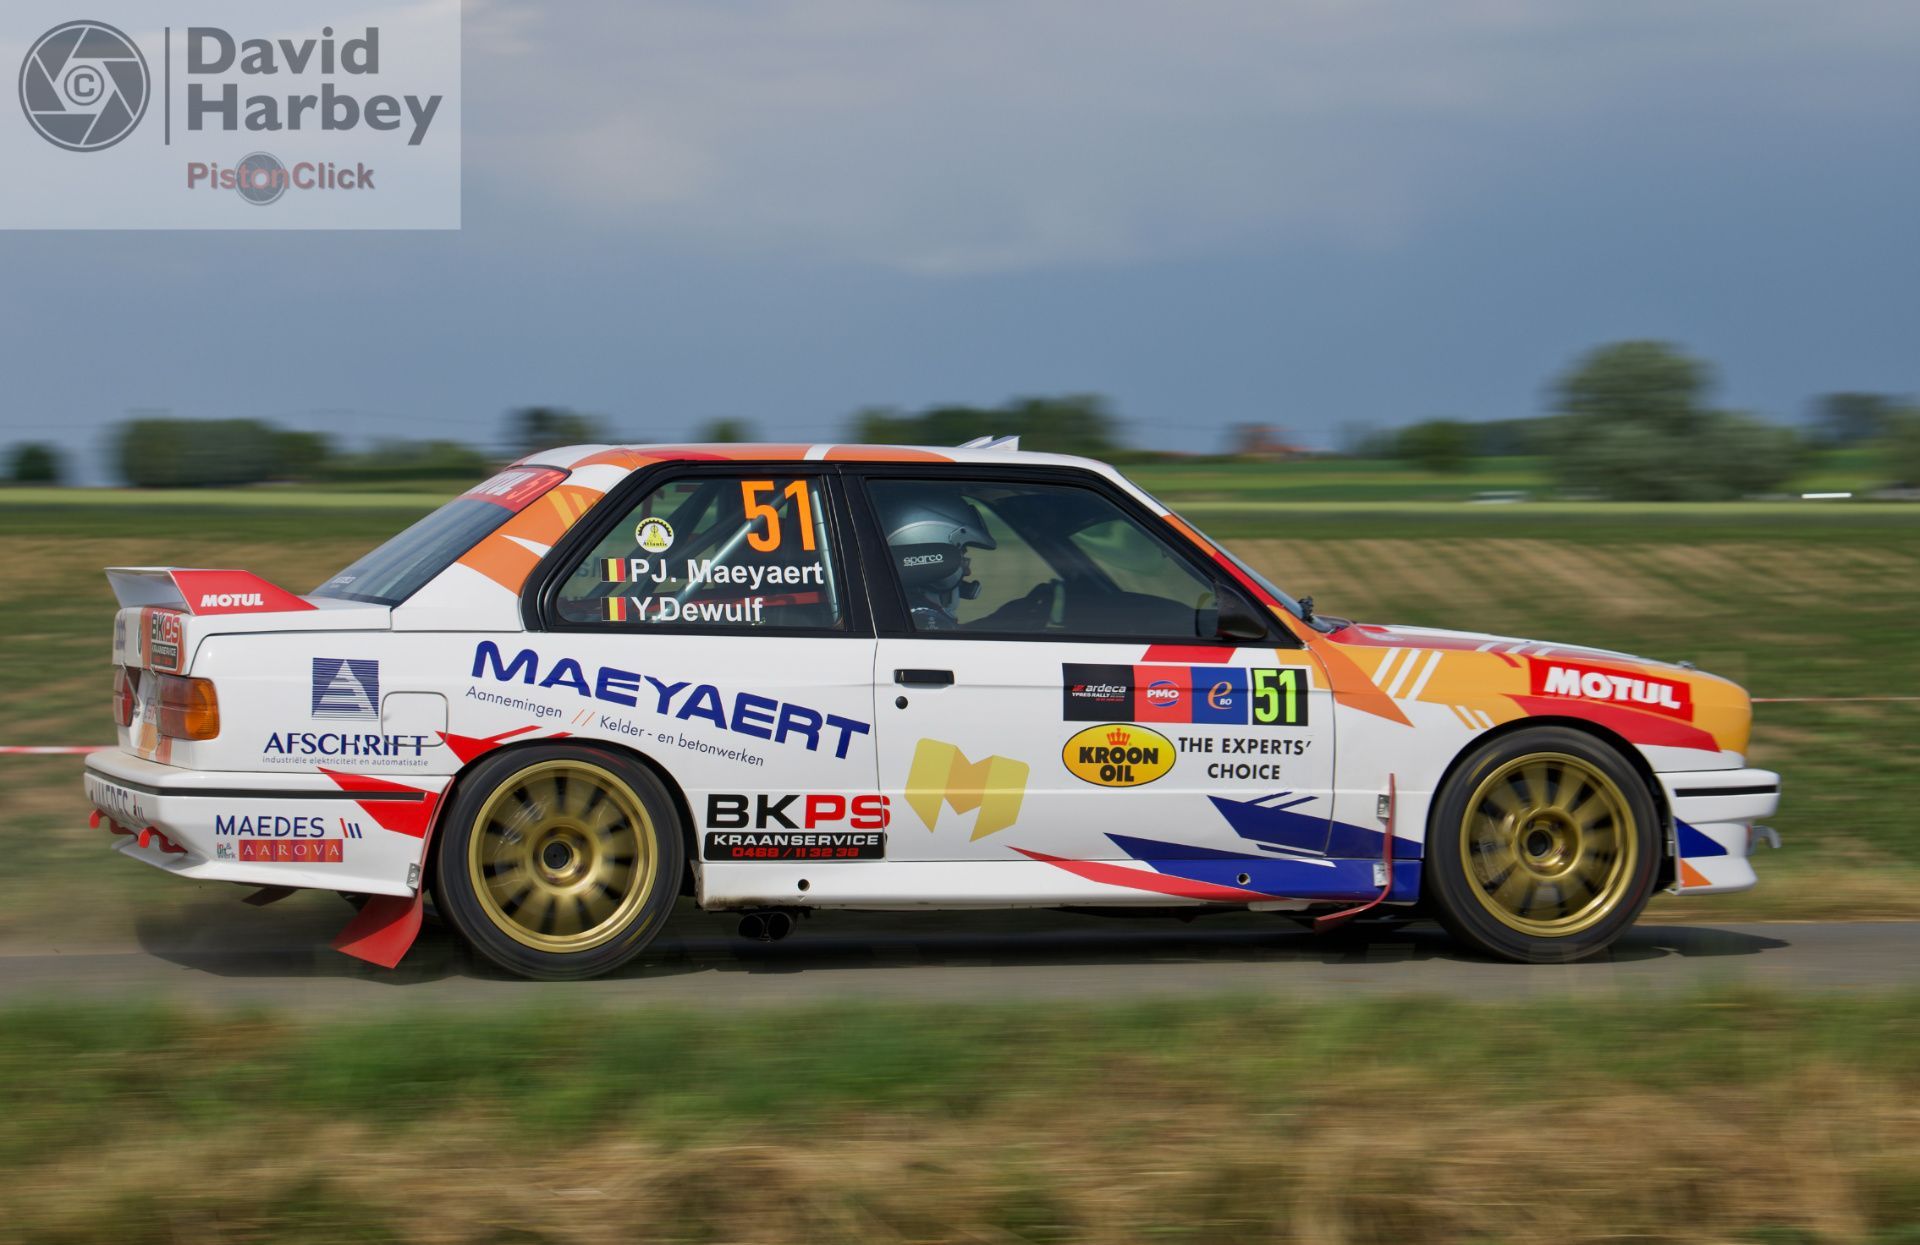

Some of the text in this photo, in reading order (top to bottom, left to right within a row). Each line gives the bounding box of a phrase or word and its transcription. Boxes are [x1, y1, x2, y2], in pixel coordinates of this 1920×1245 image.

[740, 480, 816, 552] 51
[904, 554, 943, 567] sparco
[631, 559, 677, 583] PJ.
[687, 559, 824, 590] Maeyaert
[201, 593, 264, 608] MOTUL
[1086, 684, 1127, 693] ardeca
[1147, 689, 1180, 699] PMO
[1253, 669, 1297, 723] 51
[1543, 666, 1682, 709] MOTUL
[472, 640, 870, 759] MAEYAERT
[465, 685, 563, 719] Aannemingen
[600, 714, 645, 738] Kelder
[657, 732, 675, 745] en
[678, 737, 765, 767] betonwerken
[263, 731, 429, 757] AFSCHRIFT
[1178, 737, 1213, 753] THE
[309, 757, 357, 766] elektriciteit
[371, 758, 429, 767] automatisatie
[1079, 747, 1158, 765] KROON
[1100, 765, 1134, 783] OIL
[1207, 763, 1281, 780] CHOICE
[706, 793, 891, 830] BKPS
[215, 814, 325, 838] MAEDES
[713, 834, 879, 846] KRAANSERVICE
[243, 844, 340, 856] AAROVA
